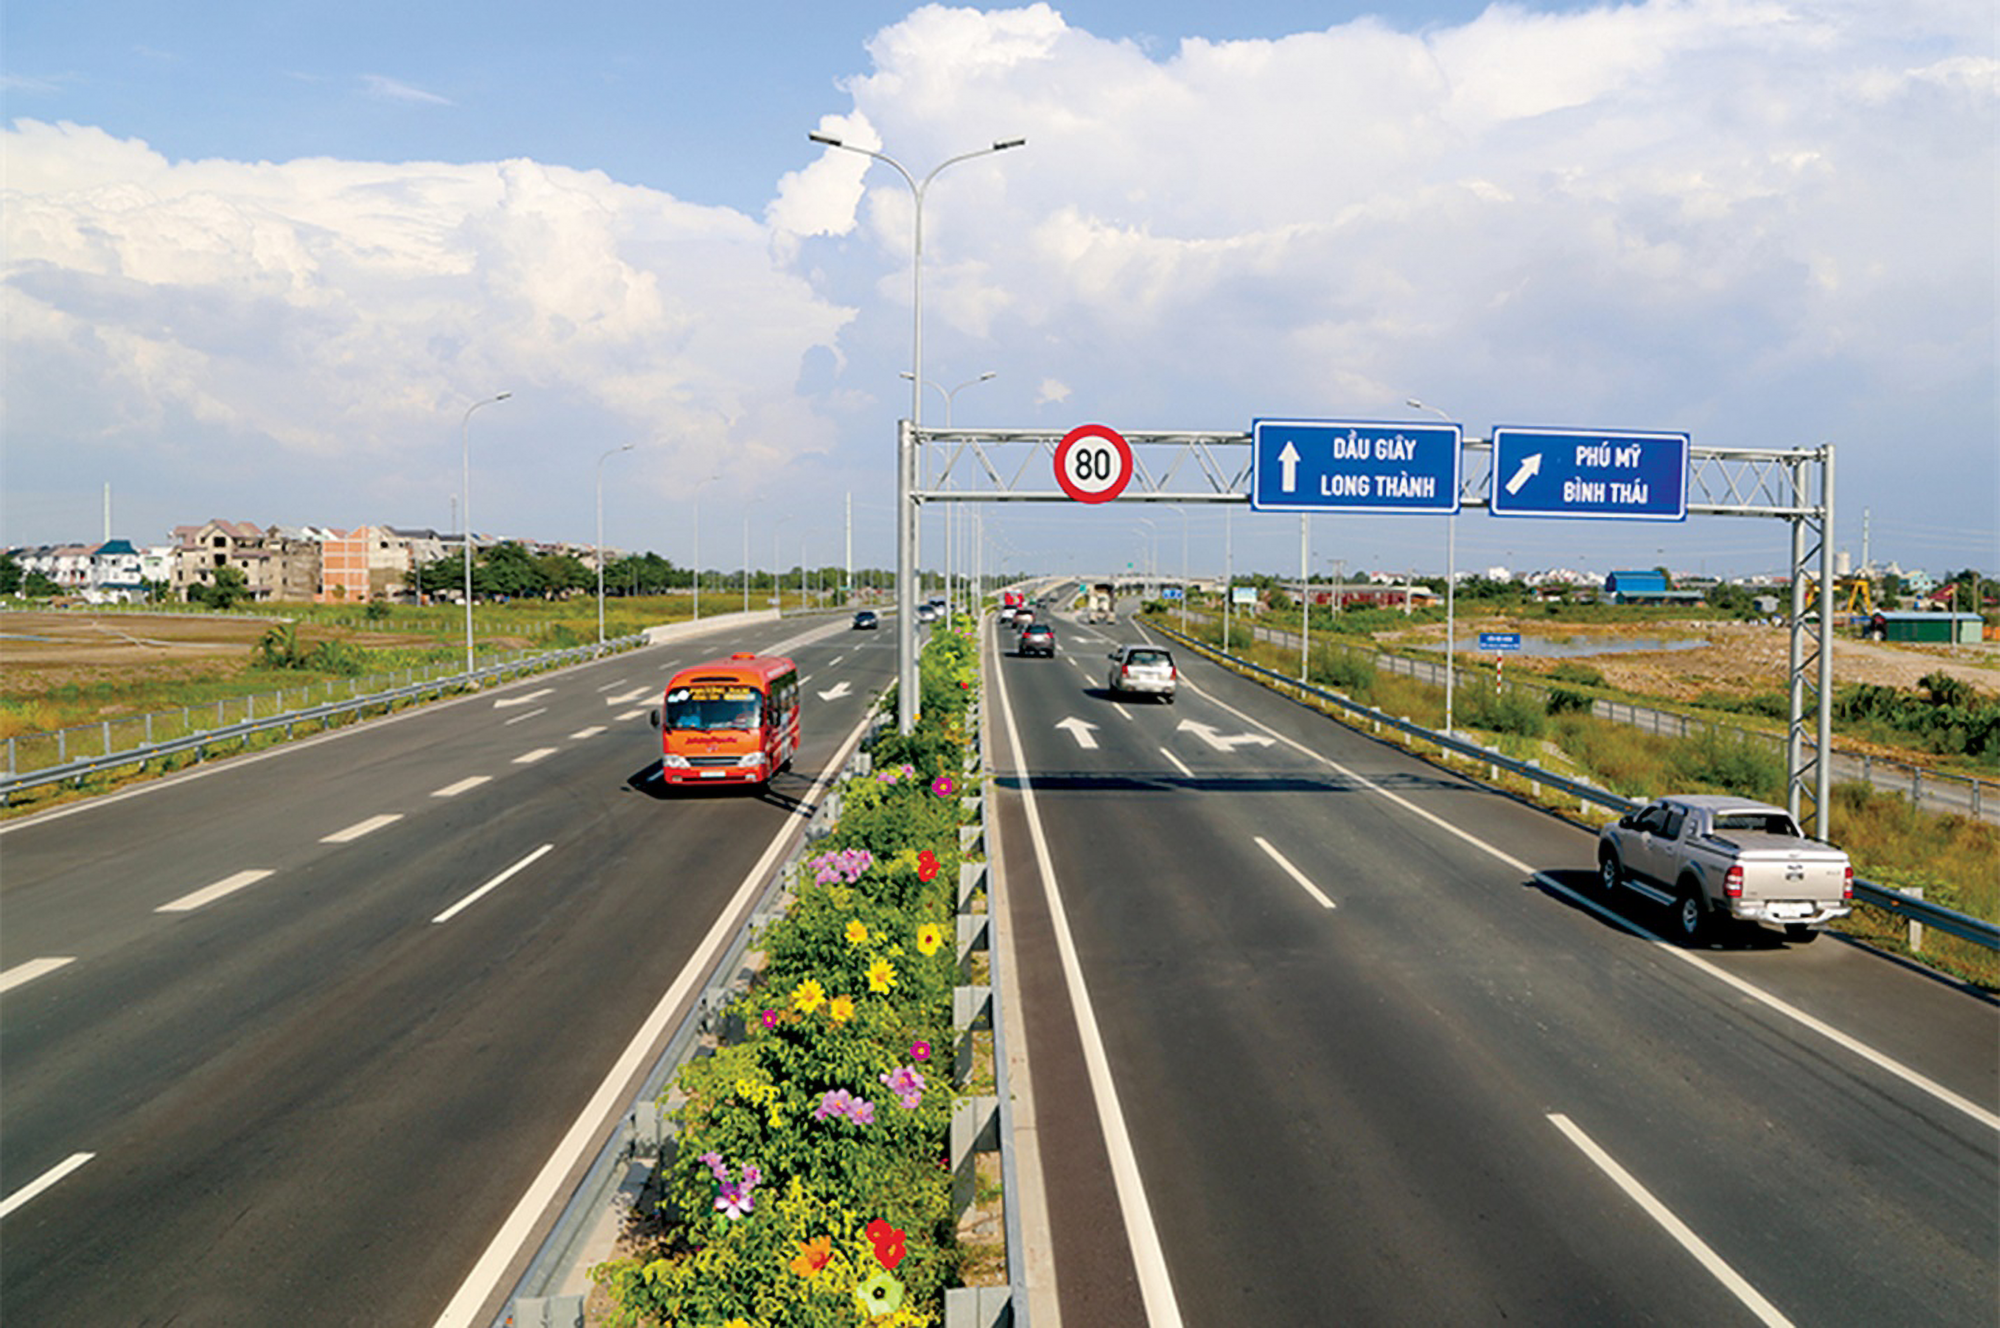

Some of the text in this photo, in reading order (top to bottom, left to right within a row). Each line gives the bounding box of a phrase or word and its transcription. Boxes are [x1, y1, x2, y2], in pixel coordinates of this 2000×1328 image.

[1375, 434, 1417, 461] GIÂY
[1576, 441, 1641, 468] PHÚ MỸ
[1076, 448, 1110, 480] 80
[1321, 470, 1435, 498] LONG THÀNH
[1563, 476, 1648, 504] BÌNH THÁI
